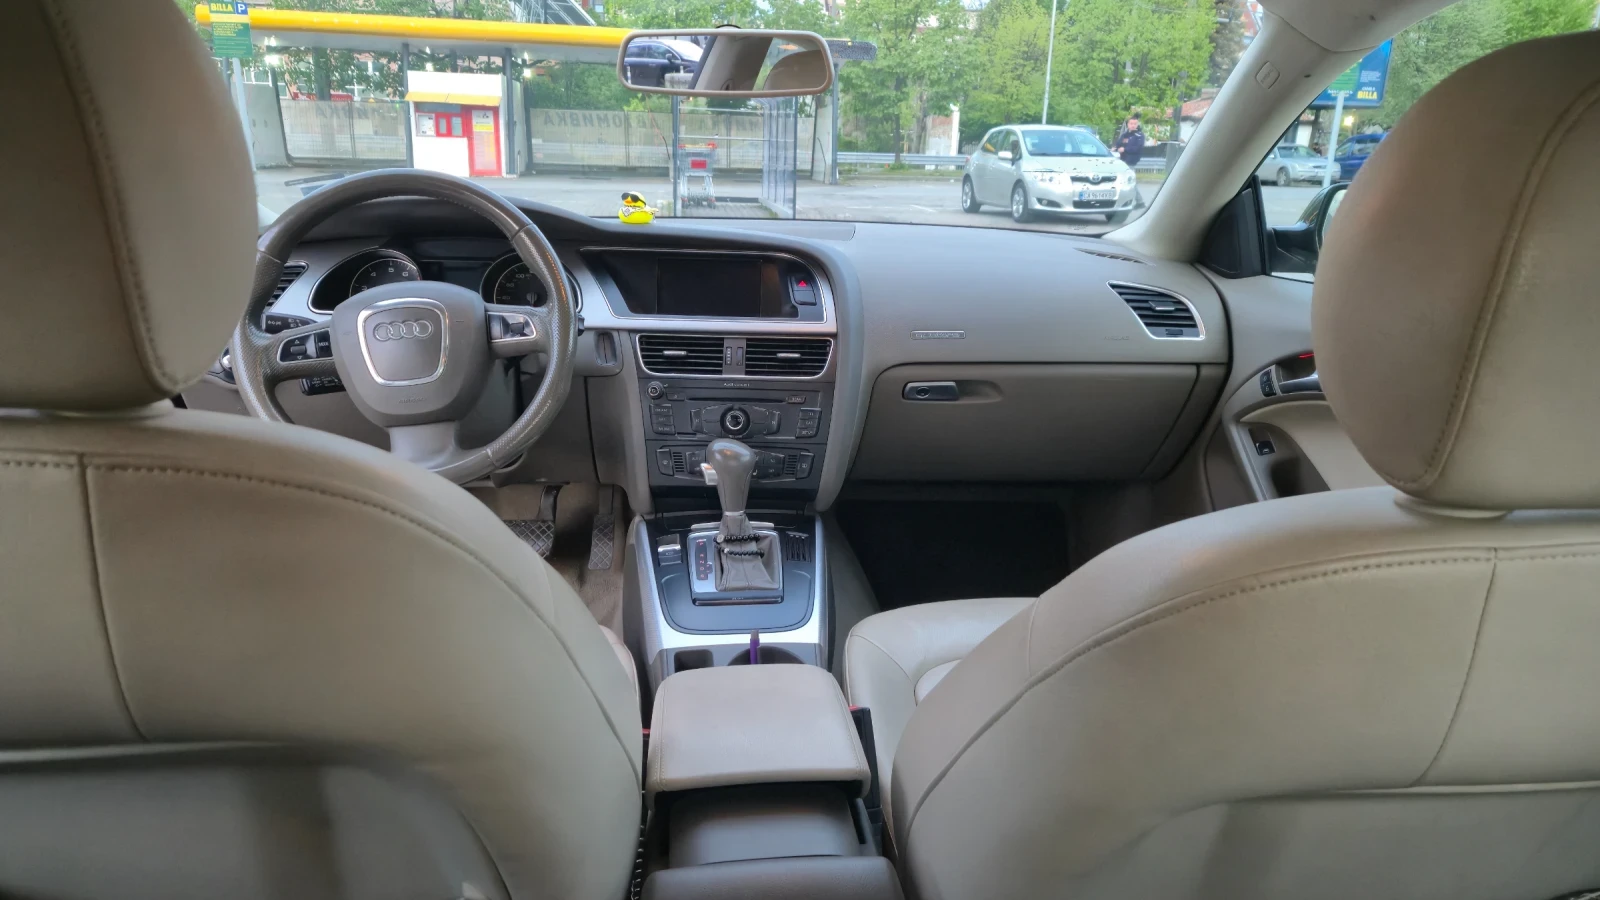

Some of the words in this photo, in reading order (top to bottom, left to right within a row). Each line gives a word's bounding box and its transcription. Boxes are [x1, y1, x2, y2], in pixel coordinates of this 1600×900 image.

[210, 3, 233, 12] BILLA
[237, 4, 246, 13] P
[1357, 91, 1378, 100] BILLA
